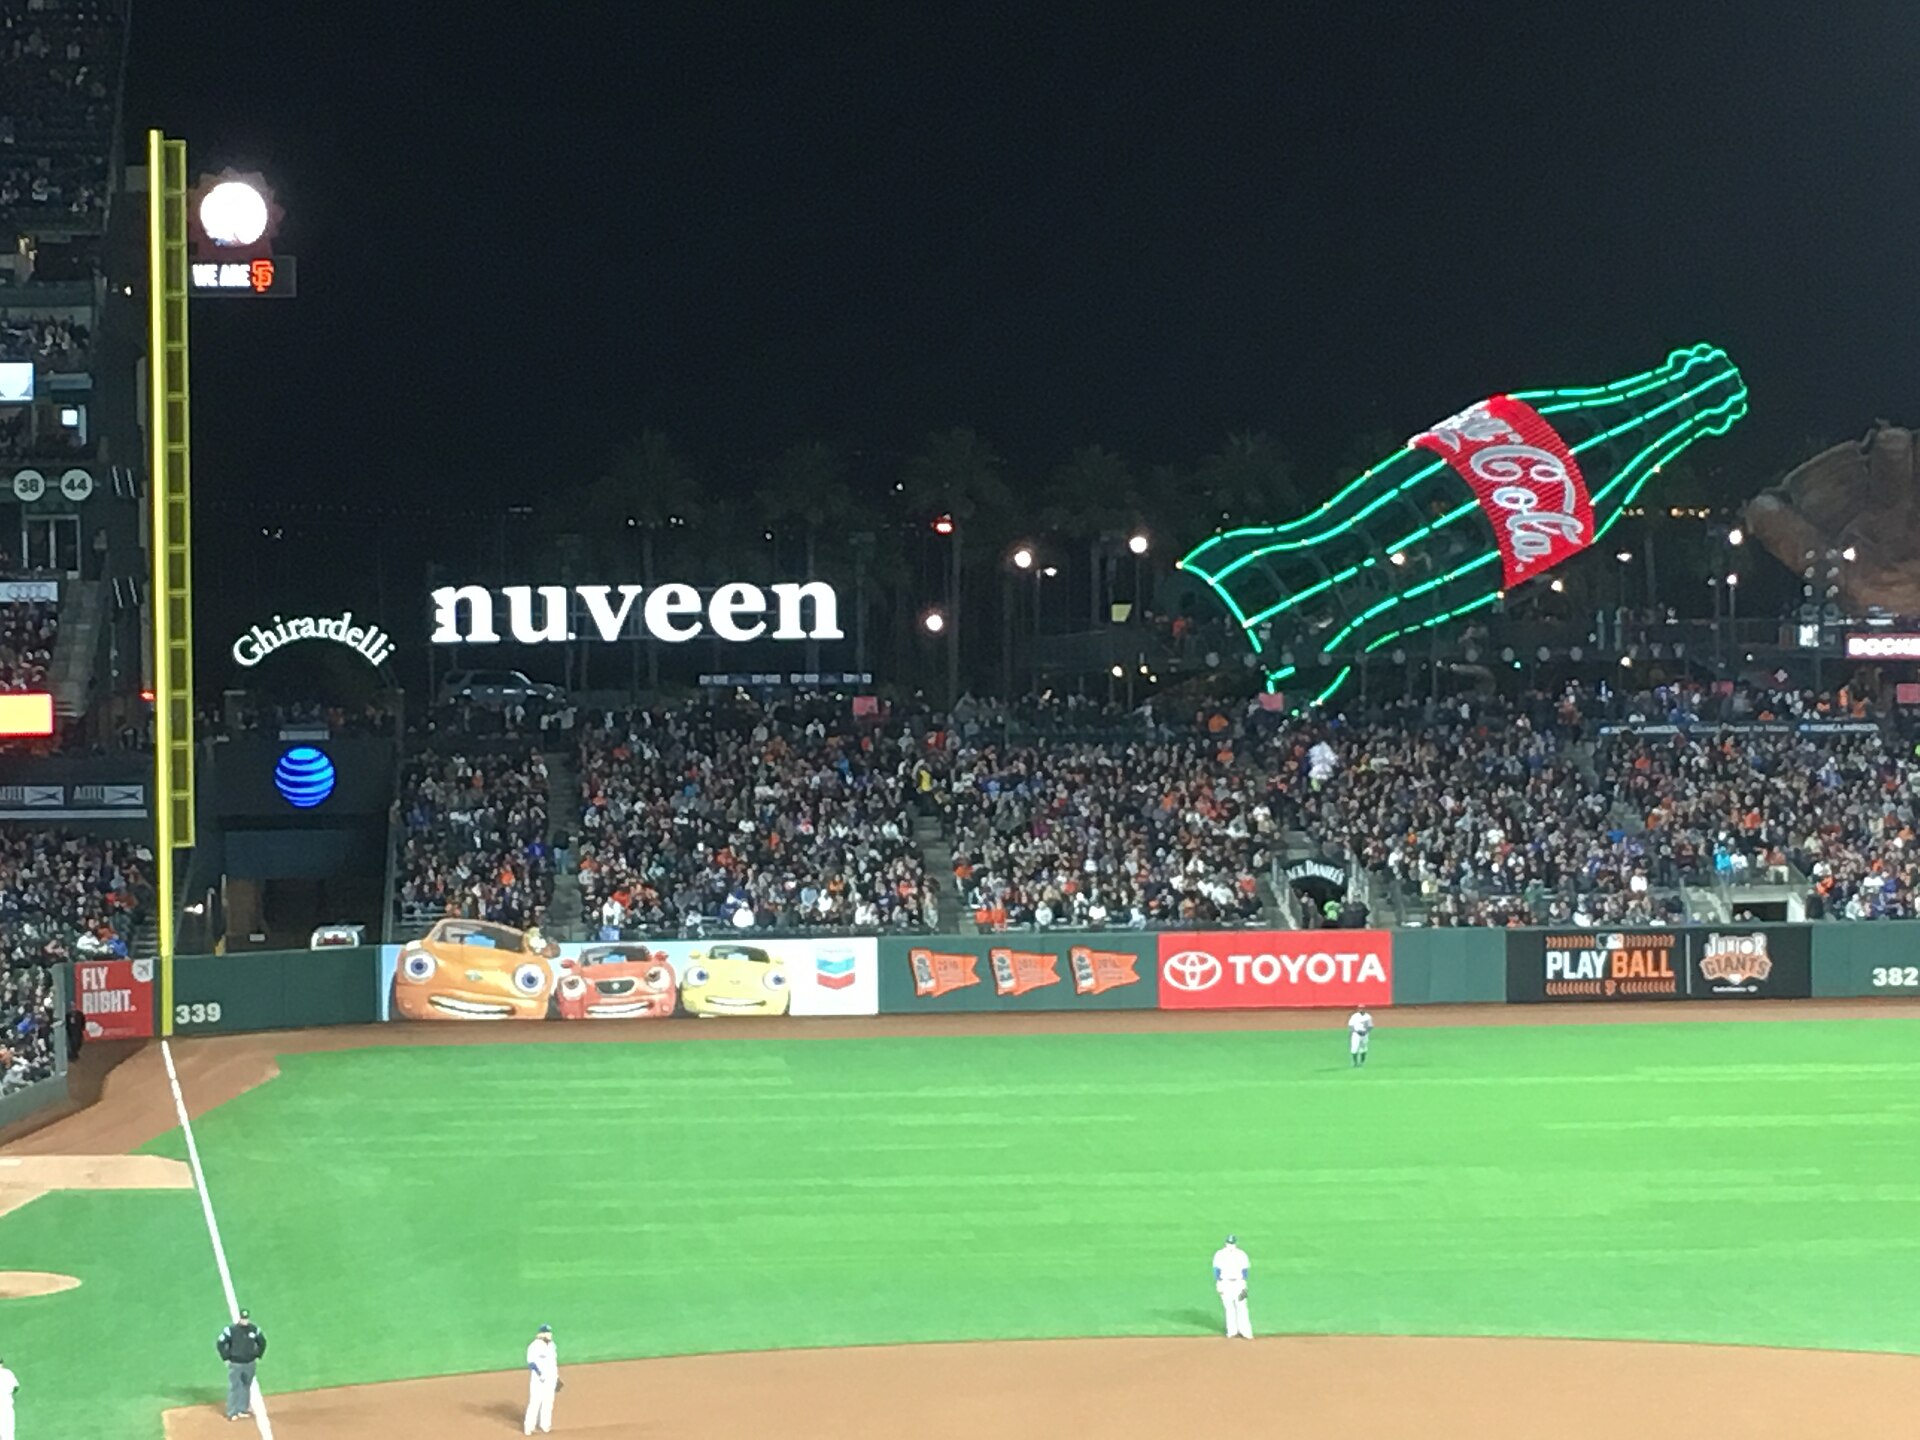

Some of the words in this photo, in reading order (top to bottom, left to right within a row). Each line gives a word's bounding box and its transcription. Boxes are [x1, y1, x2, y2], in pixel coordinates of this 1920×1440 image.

[192, 264, 218, 287] WE
[19, 479, 39, 493] 38
[65, 478, 88, 491] 44
[431, 581, 845, 643] nuveen
[233, 611, 396, 667] Ghirardelli
[1704, 932, 1766, 958] JUNIOR
[1228, 953, 1387, 985] TOYOTA
[1546, 951, 1608, 979] PLAY
[1611, 950, 1674, 978] BALL
[1704, 955, 1769, 977] GIANTS
[1872, 966, 1919, 987] 382
[82, 966, 108, 990] FLY
[82, 989, 136, 1014] RIGHT.
[175, 1002, 221, 1025] 339
